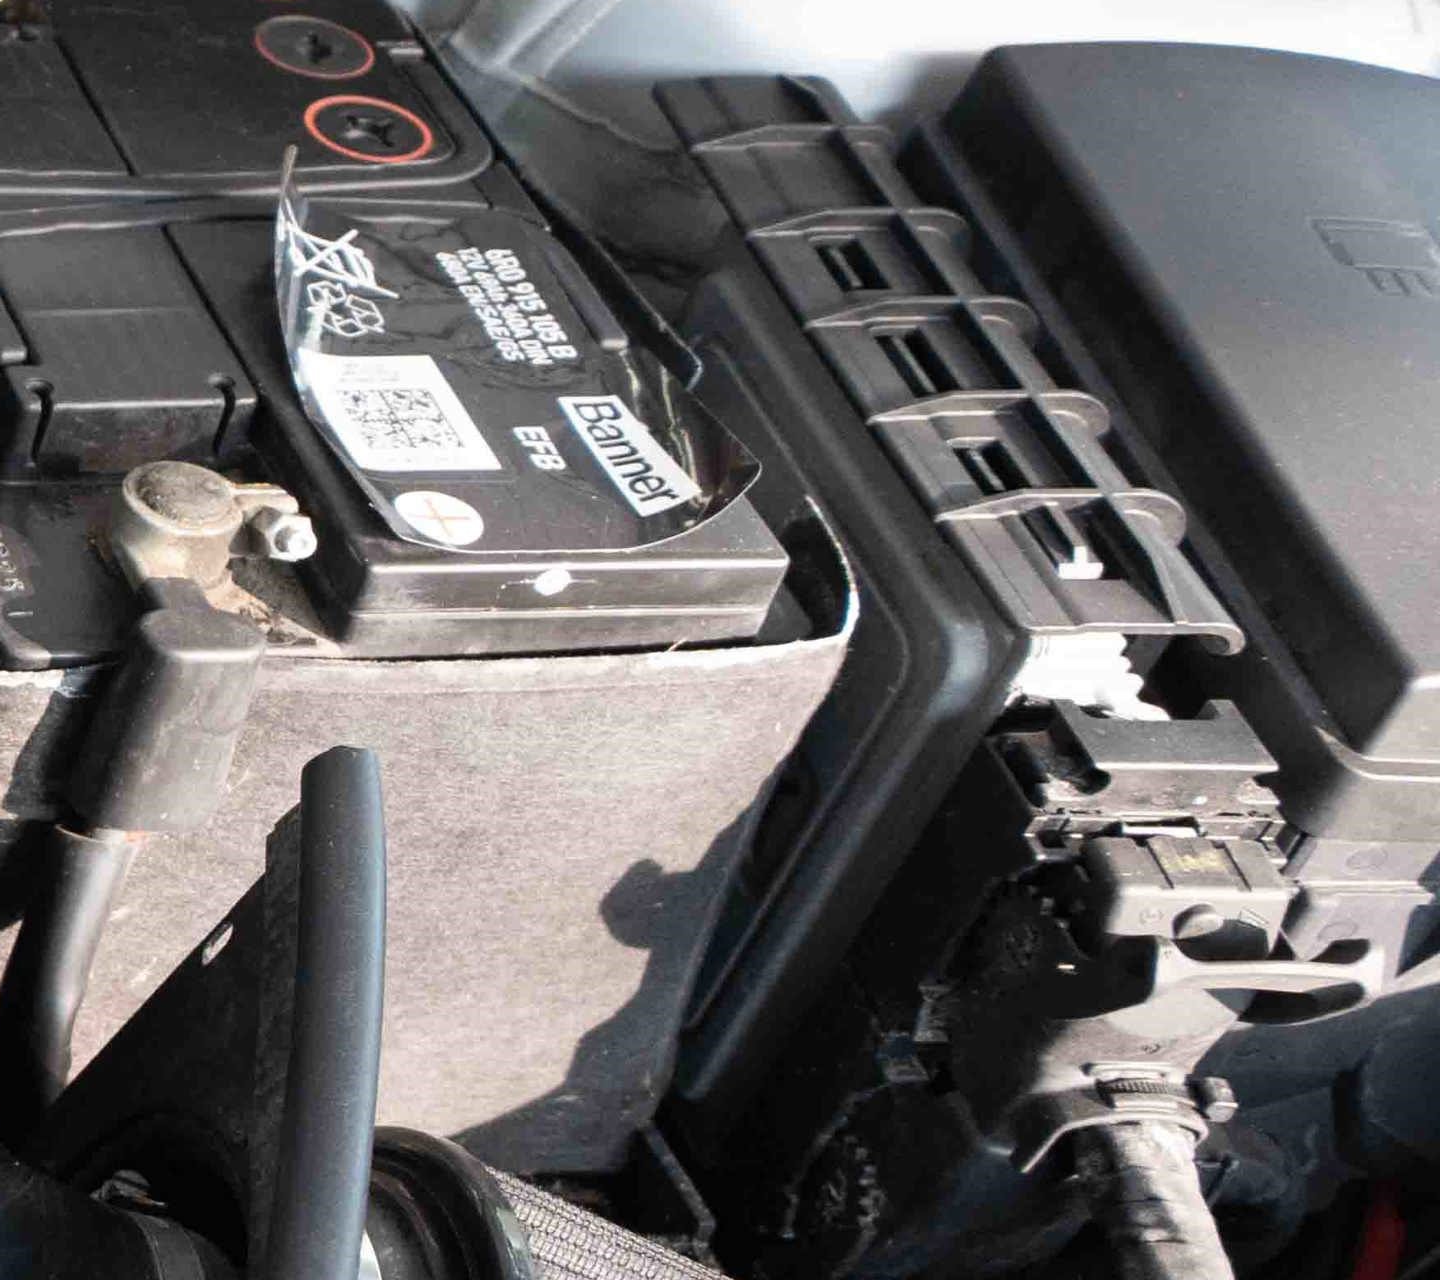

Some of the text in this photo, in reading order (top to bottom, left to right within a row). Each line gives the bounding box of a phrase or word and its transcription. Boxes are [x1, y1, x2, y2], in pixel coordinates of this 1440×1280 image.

[507, 282, 547, 311] 915
[529, 314, 568, 343] 105
[547, 345, 578, 359] B
[512, 426, 567, 470] EFB
[572, 402, 679, 502] Banner
